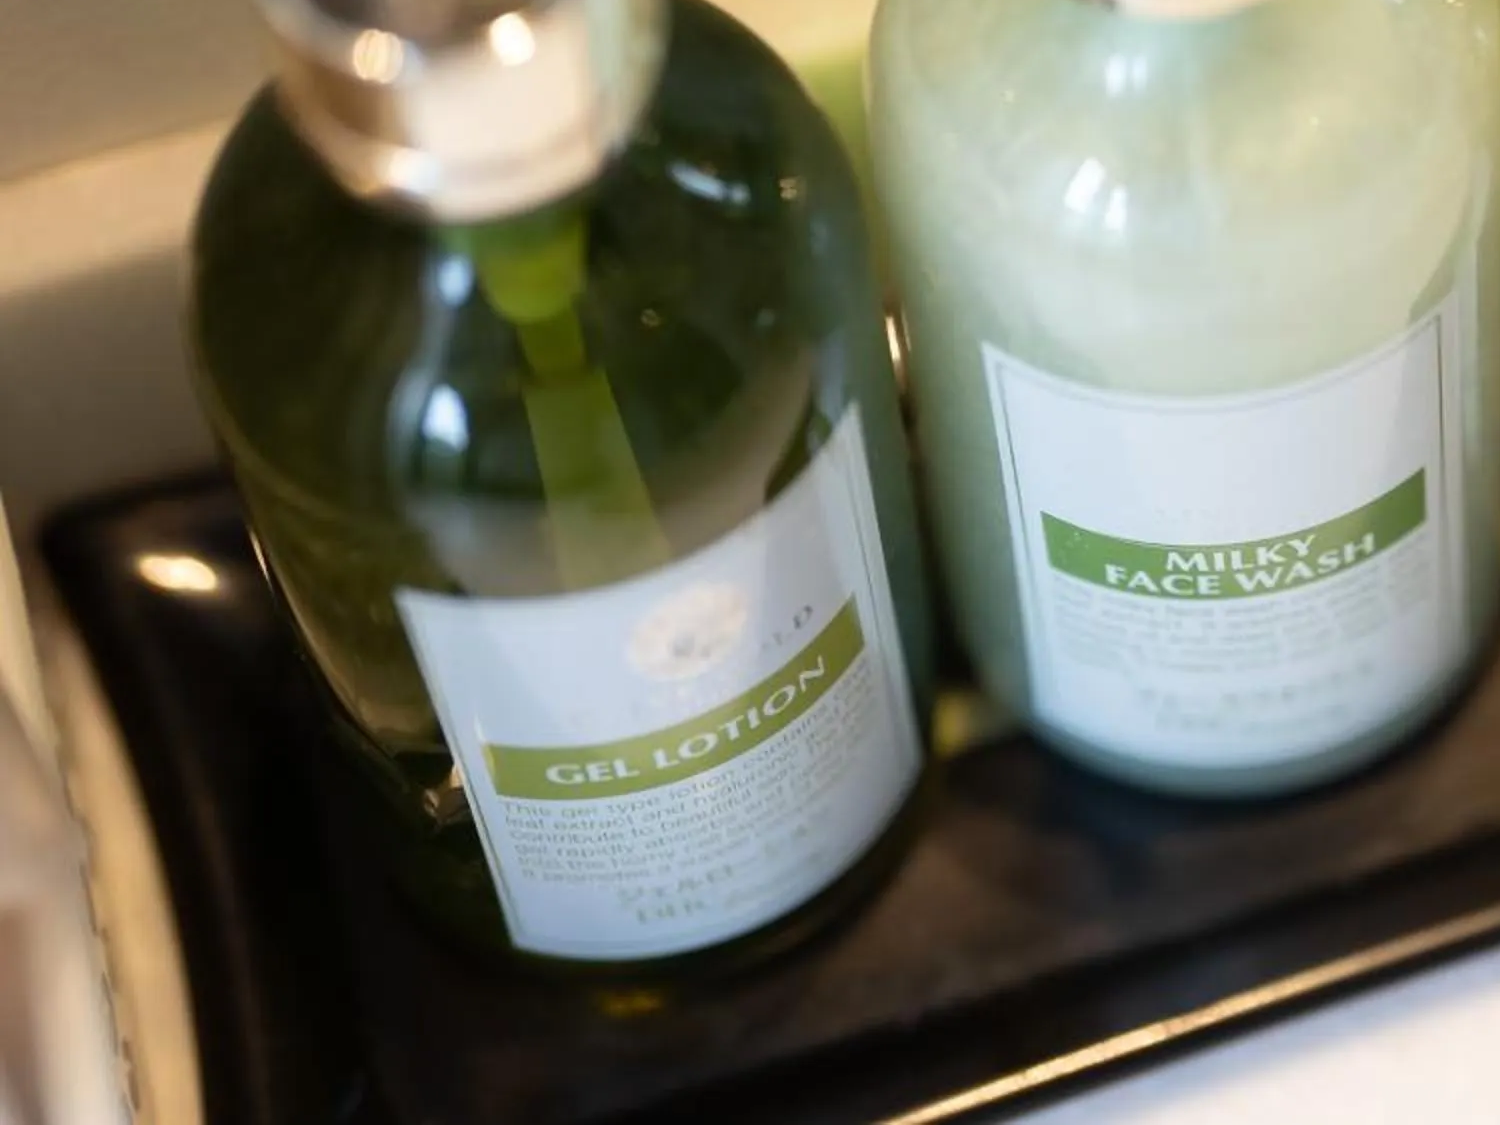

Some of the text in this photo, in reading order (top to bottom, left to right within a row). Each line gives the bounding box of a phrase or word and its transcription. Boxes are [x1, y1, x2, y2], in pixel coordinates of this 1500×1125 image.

[1104, 532, 1375, 596] FACE WASH
[1166, 534, 1316, 572] MILKY
[545, 757, 640, 784] GEL
[653, 655, 826, 770] LOTION
